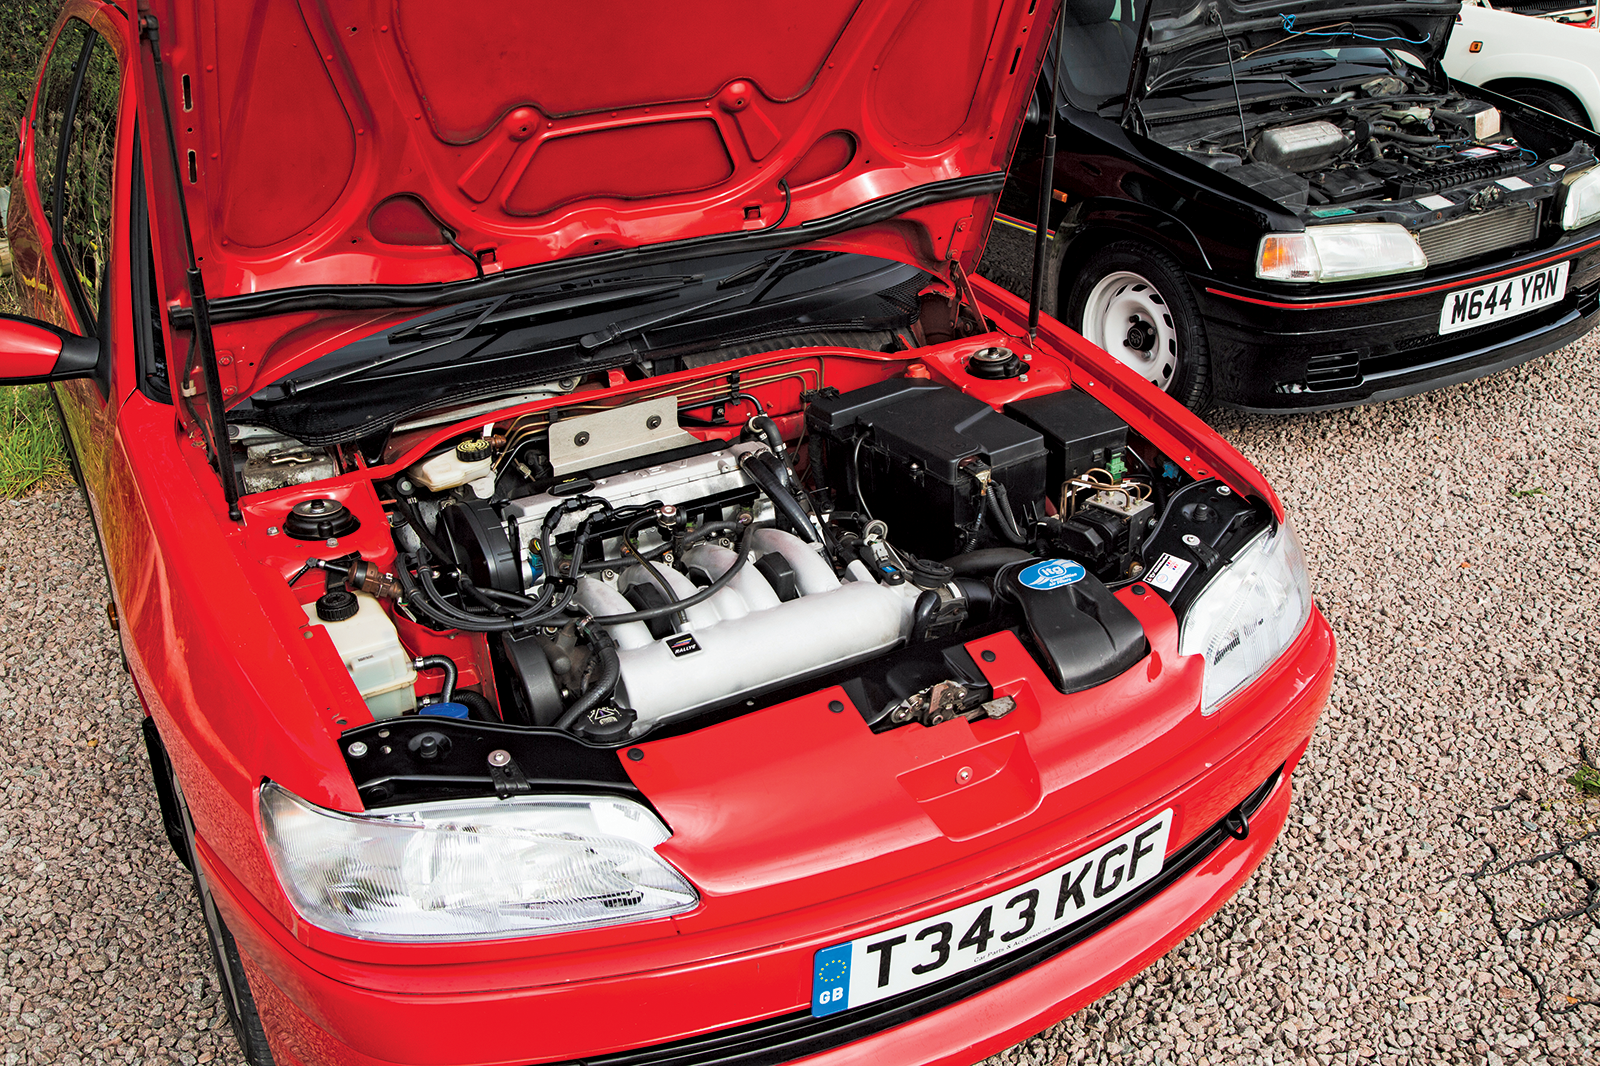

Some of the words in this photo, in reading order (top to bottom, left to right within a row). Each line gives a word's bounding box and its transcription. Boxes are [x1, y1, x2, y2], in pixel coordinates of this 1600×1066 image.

[1451, 282, 1513, 324] M644
[1521, 267, 1559, 306] YRN
[675, 644, 696, 654] RALLYE
[866, 888, 1040, 988] T343
[1054, 820, 1163, 920] KGF
[973, 955, 986, 963] Car
[988, 948, 1004, 957] Parts
[1013, 927, 1051, 946] Accessories
[819, 987, 844, 1004] GB
